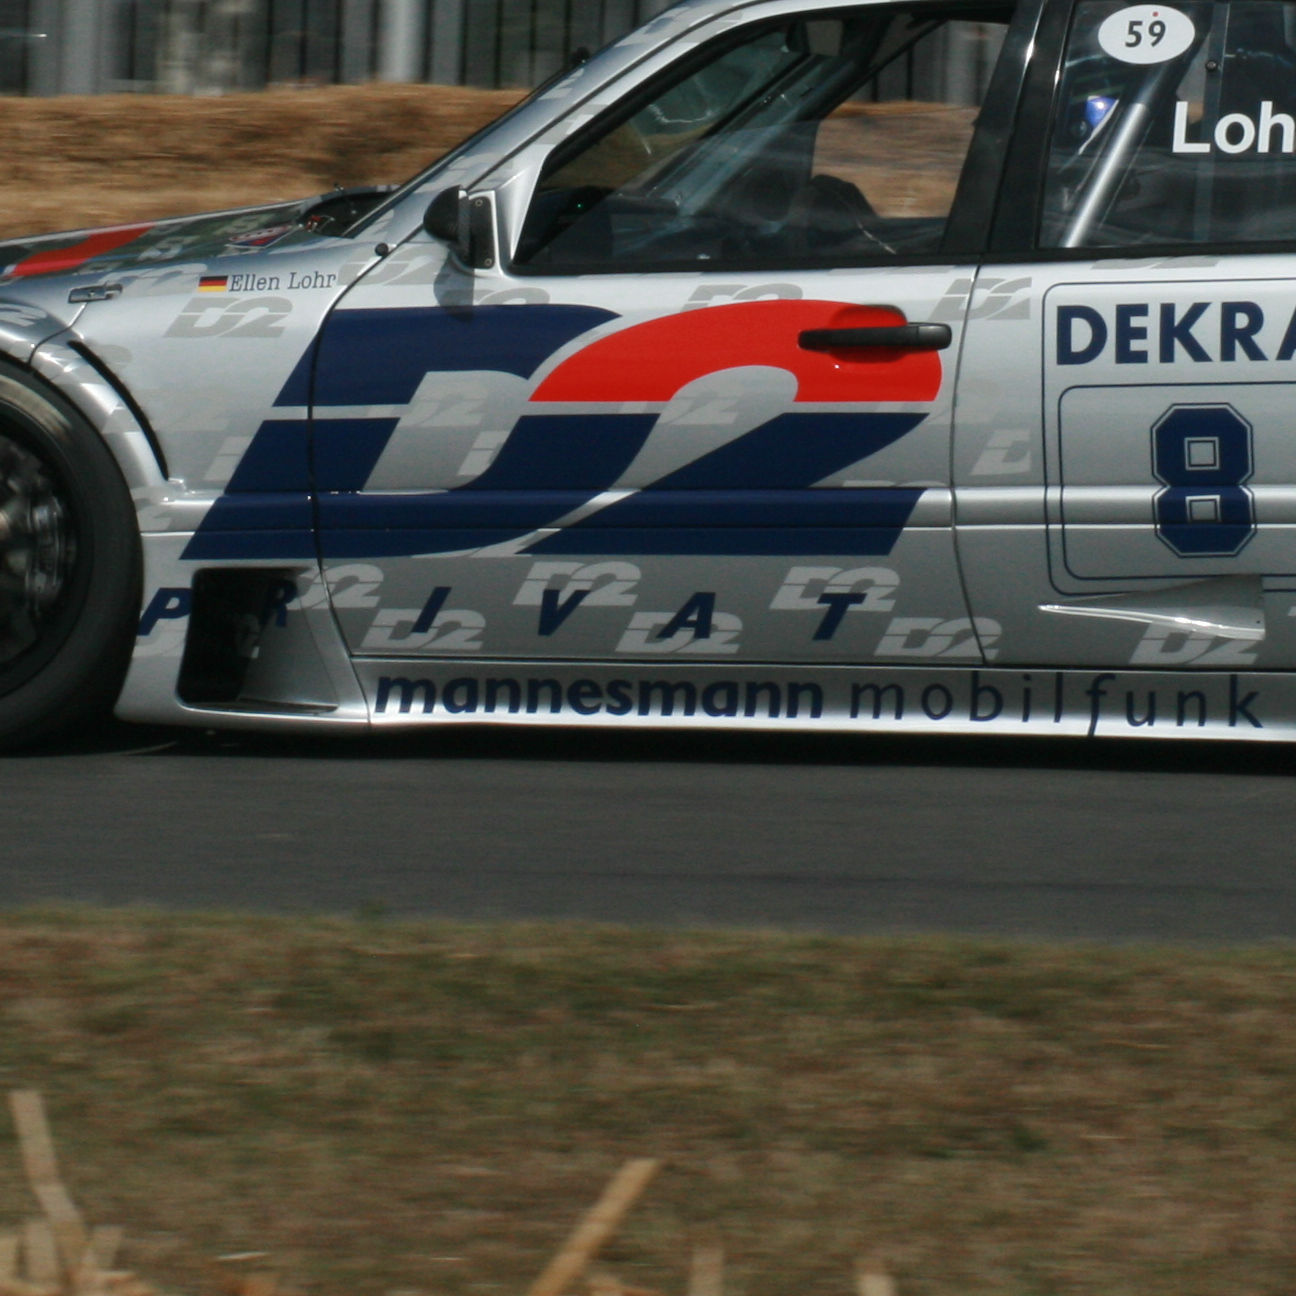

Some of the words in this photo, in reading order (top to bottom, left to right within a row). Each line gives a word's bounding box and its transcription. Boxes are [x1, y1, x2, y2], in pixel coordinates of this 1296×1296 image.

[1124, 20, 1166, 48] 59
[228, 273, 280, 293] Ellen
[287, 270, 337, 290] Lohr
[163, 297, 294, 338] D2
[179, 298, 942, 561] D2
[1151, 402, 1258, 558] 8
[512, 561, 642, 606] D2
[770, 566, 900, 611] D2
[360, 609, 487, 651] D2
[615, 612, 743, 655] D2
[874, 616, 1002, 658] D2
[374, 675, 823, 720] mannesmann
[849, 672, 1264, 736] mobilfunk
